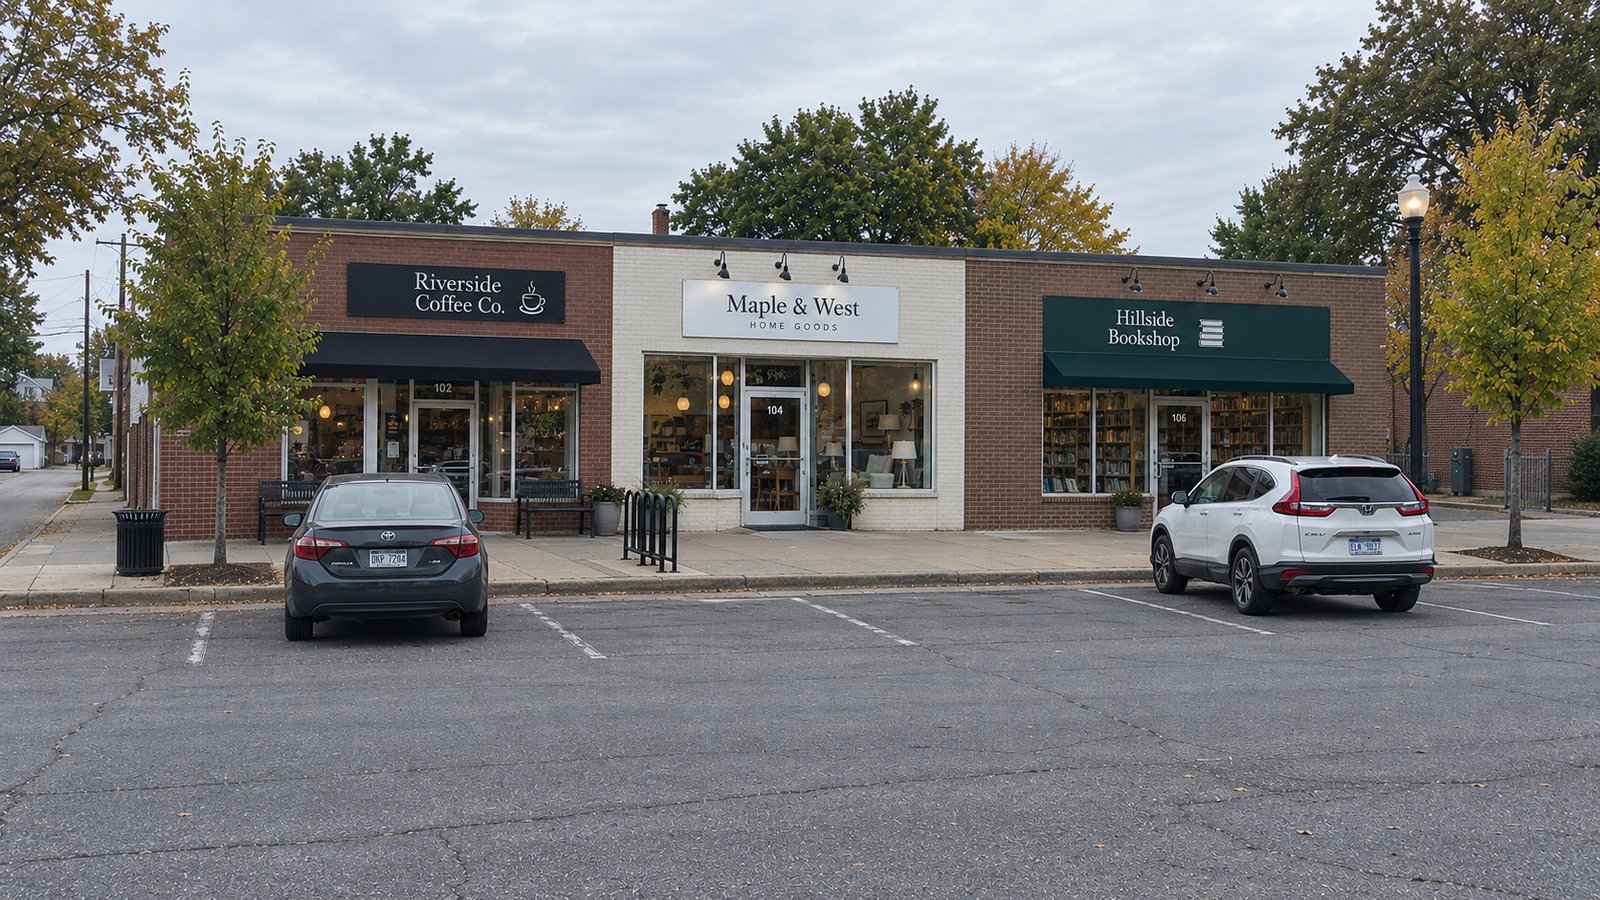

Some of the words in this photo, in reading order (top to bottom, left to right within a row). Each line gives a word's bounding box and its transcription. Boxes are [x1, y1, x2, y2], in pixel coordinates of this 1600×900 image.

[414, 272, 502, 293] Riverside
[415, 294, 472, 313] Coffee
[478, 296, 505, 314] Co.
[726, 294, 787, 319] Maple
[793, 298, 807, 315] &
[813, 297, 860, 317] West
[750, 321, 785, 330] HOME
[794, 323, 838, 331] GOODS
[1116, 309, 1174, 327] Hillside
[1108, 328, 1180, 351] Bookshop
[434, 383, 452, 393] 102
[767, 405, 783, 415] 104
[1171, 413, 1187, 422] 106
